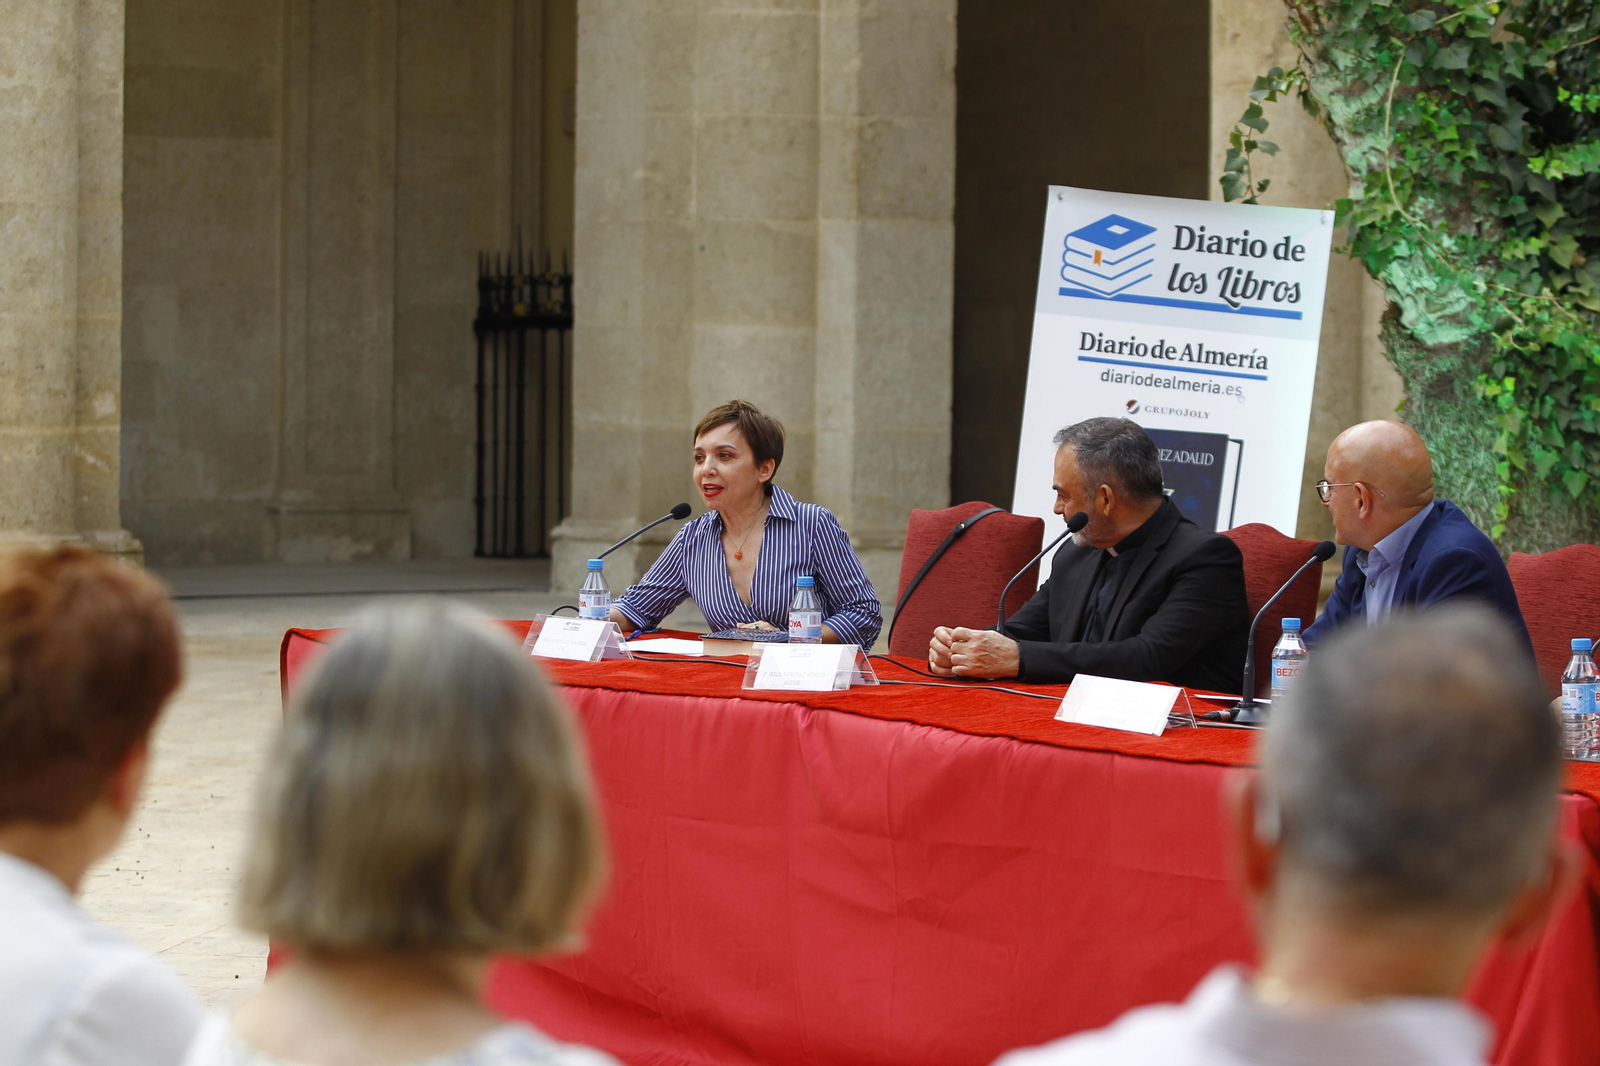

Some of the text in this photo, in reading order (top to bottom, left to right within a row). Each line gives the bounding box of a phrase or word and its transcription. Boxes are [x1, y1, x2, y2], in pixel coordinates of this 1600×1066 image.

[1172, 224, 1306, 262] Diario de
[1167, 263, 1302, 309] los Libros
[1079, 331, 1269, 370] Diario de Almería
[1100, 368, 1243, 397] diariodealmeria.es
[1173, 450, 1215, 466] ADALID
[1276, 667, 1304, 678] BEZO
